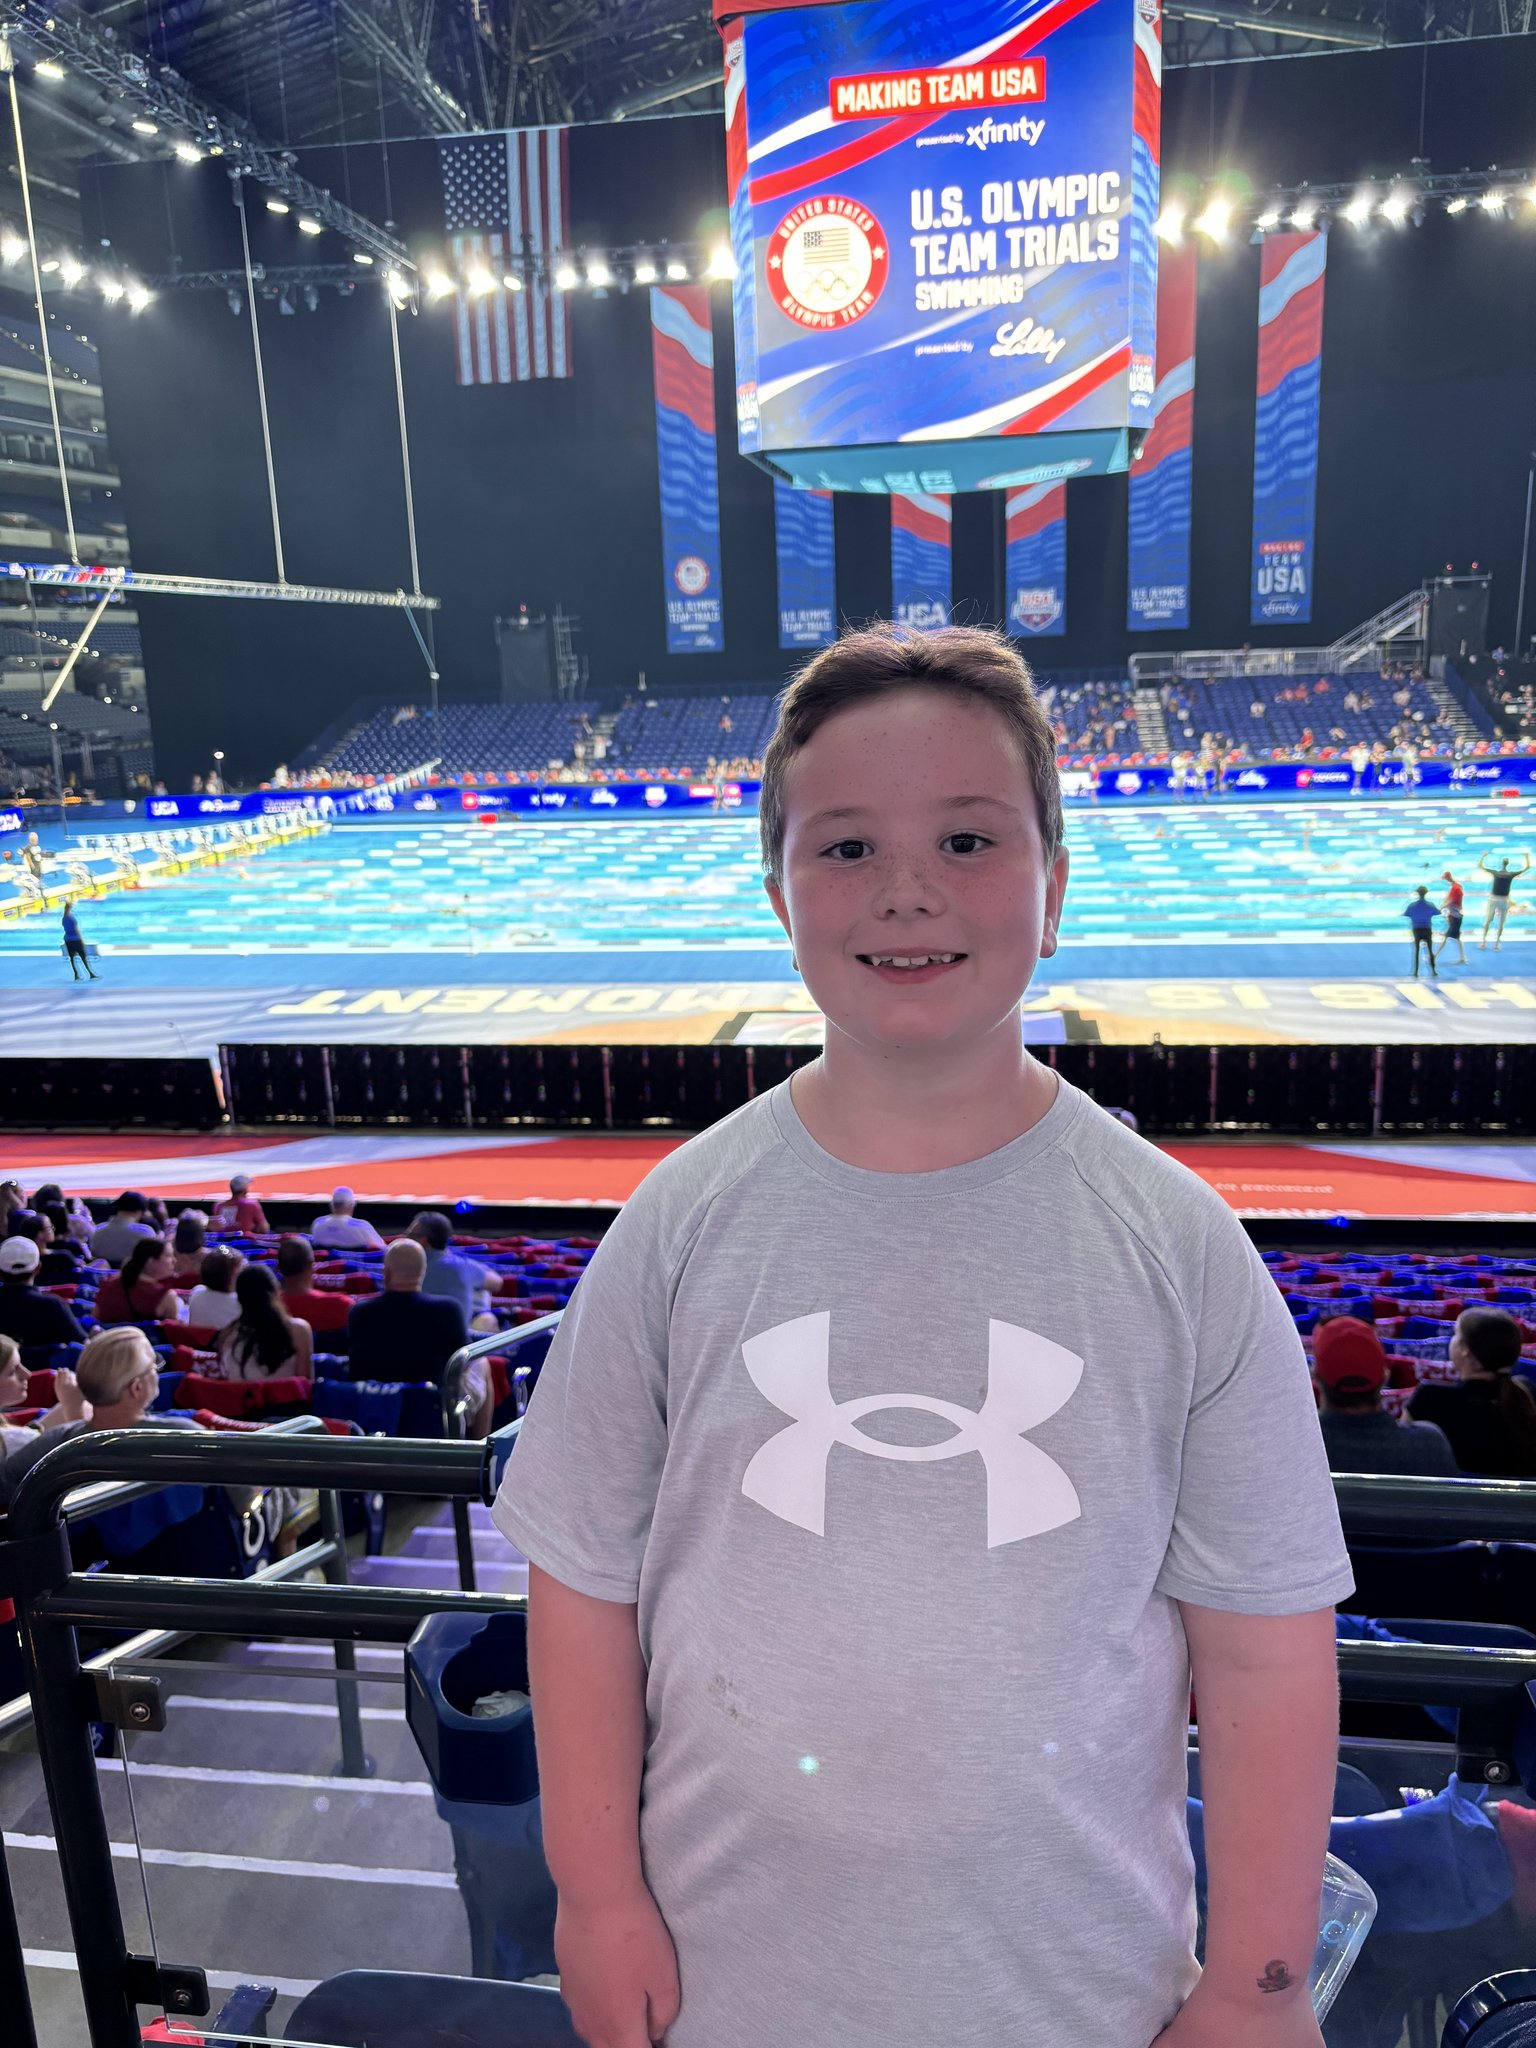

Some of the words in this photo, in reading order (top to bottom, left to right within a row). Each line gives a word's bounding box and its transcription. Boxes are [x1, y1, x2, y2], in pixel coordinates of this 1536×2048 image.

[837, 79, 921, 114] MAKING
[926, 71, 984, 104] TEAM
[991, 66, 1037, 98] USA
[966, 115, 1046, 151] xfinity
[777, 200, 823, 240] UNITED
[827, 198, 875, 232] STATES
[910, 187, 972, 231] U.S.
[981, 171, 1120, 224] OLYMPIC
[910, 230, 997, 277] TEAM
[1005, 219, 1119, 269] TRIALS
[781, 295, 836, 328] OLYMPIC
[840, 291, 875, 323] TEAM
[915, 273, 1024, 311] SWIMMING
[989, 317, 1066, 364] Lilly
[1257, 566, 1306, 595] USA
[897, 602, 947, 627] USA
[267, 988, 751, 1015] MOMENT
[1145, 984, 1273, 1010] IS
